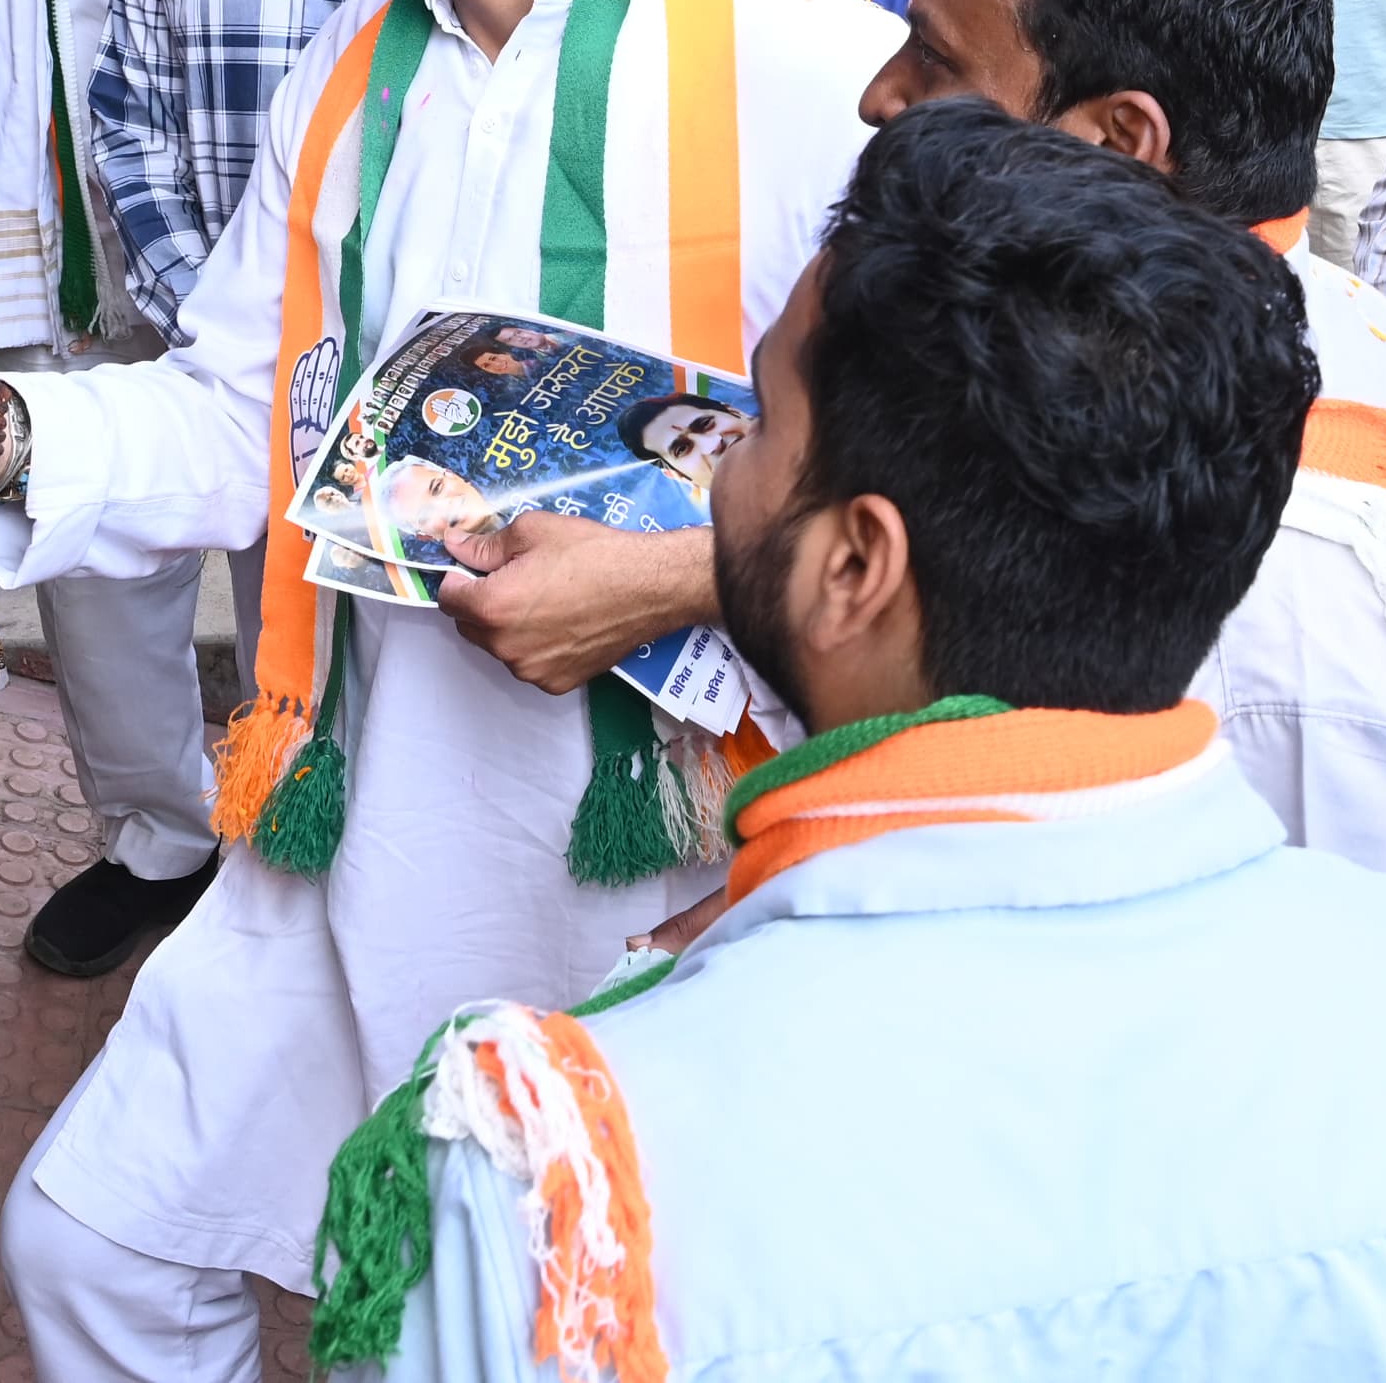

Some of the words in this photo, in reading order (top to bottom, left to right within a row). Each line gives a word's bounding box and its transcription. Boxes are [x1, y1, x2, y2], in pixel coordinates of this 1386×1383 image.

[483, 409, 539, 470] मुझे
[520, 344, 605, 410] जरूरत
[546, 422, 592, 450] है
[576, 361, 645, 425] आपके
[604, 492, 635, 524] की
